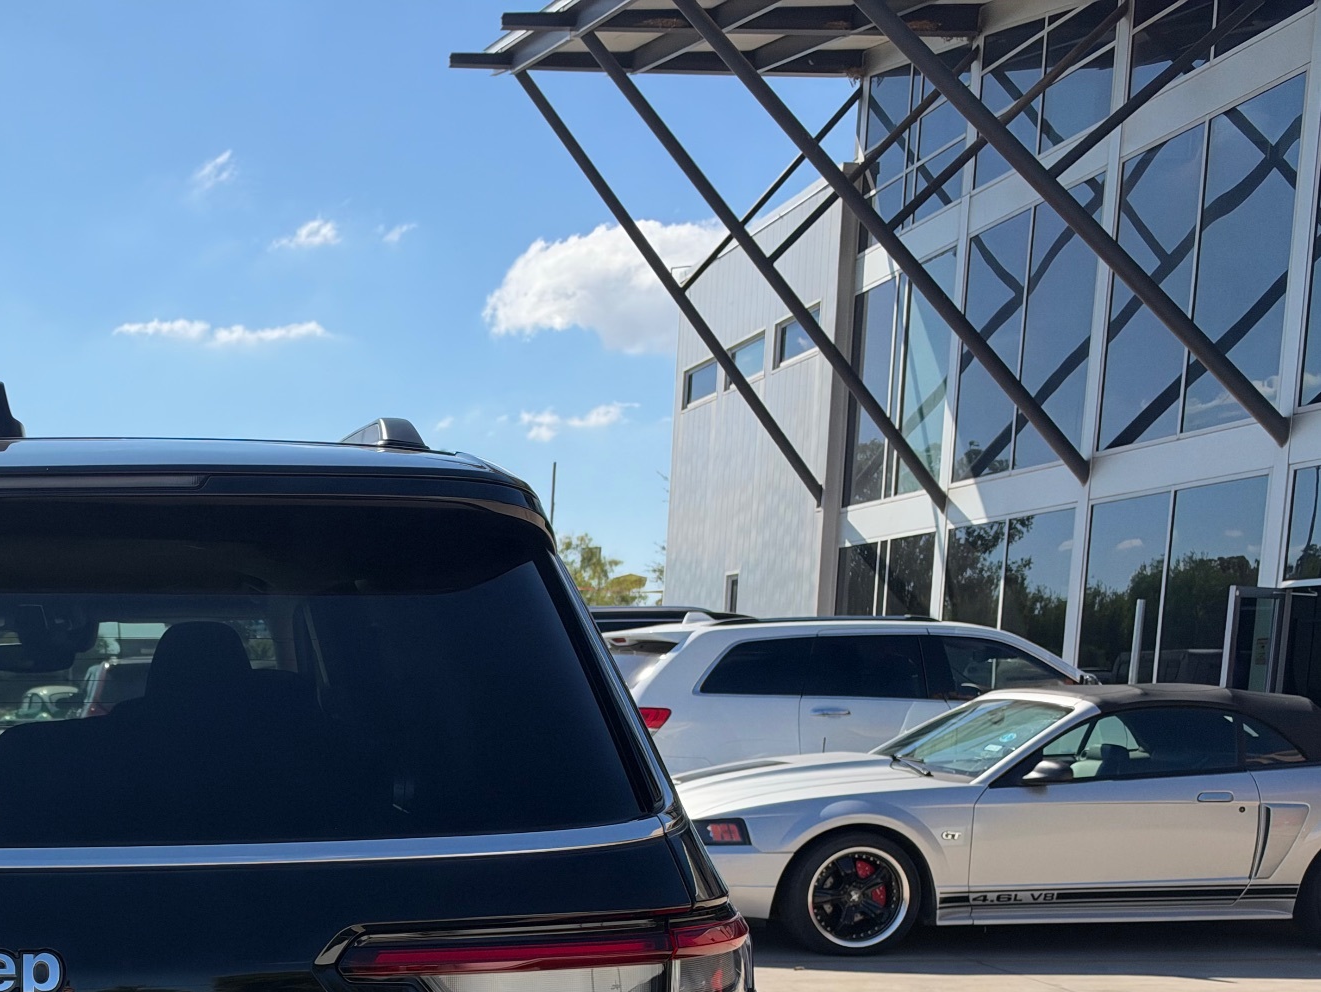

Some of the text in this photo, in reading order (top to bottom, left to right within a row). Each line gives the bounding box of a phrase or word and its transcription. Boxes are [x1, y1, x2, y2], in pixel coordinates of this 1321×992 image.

[941, 830, 962, 840] GT
[972, 892, 1055, 903] 4.6L V8
